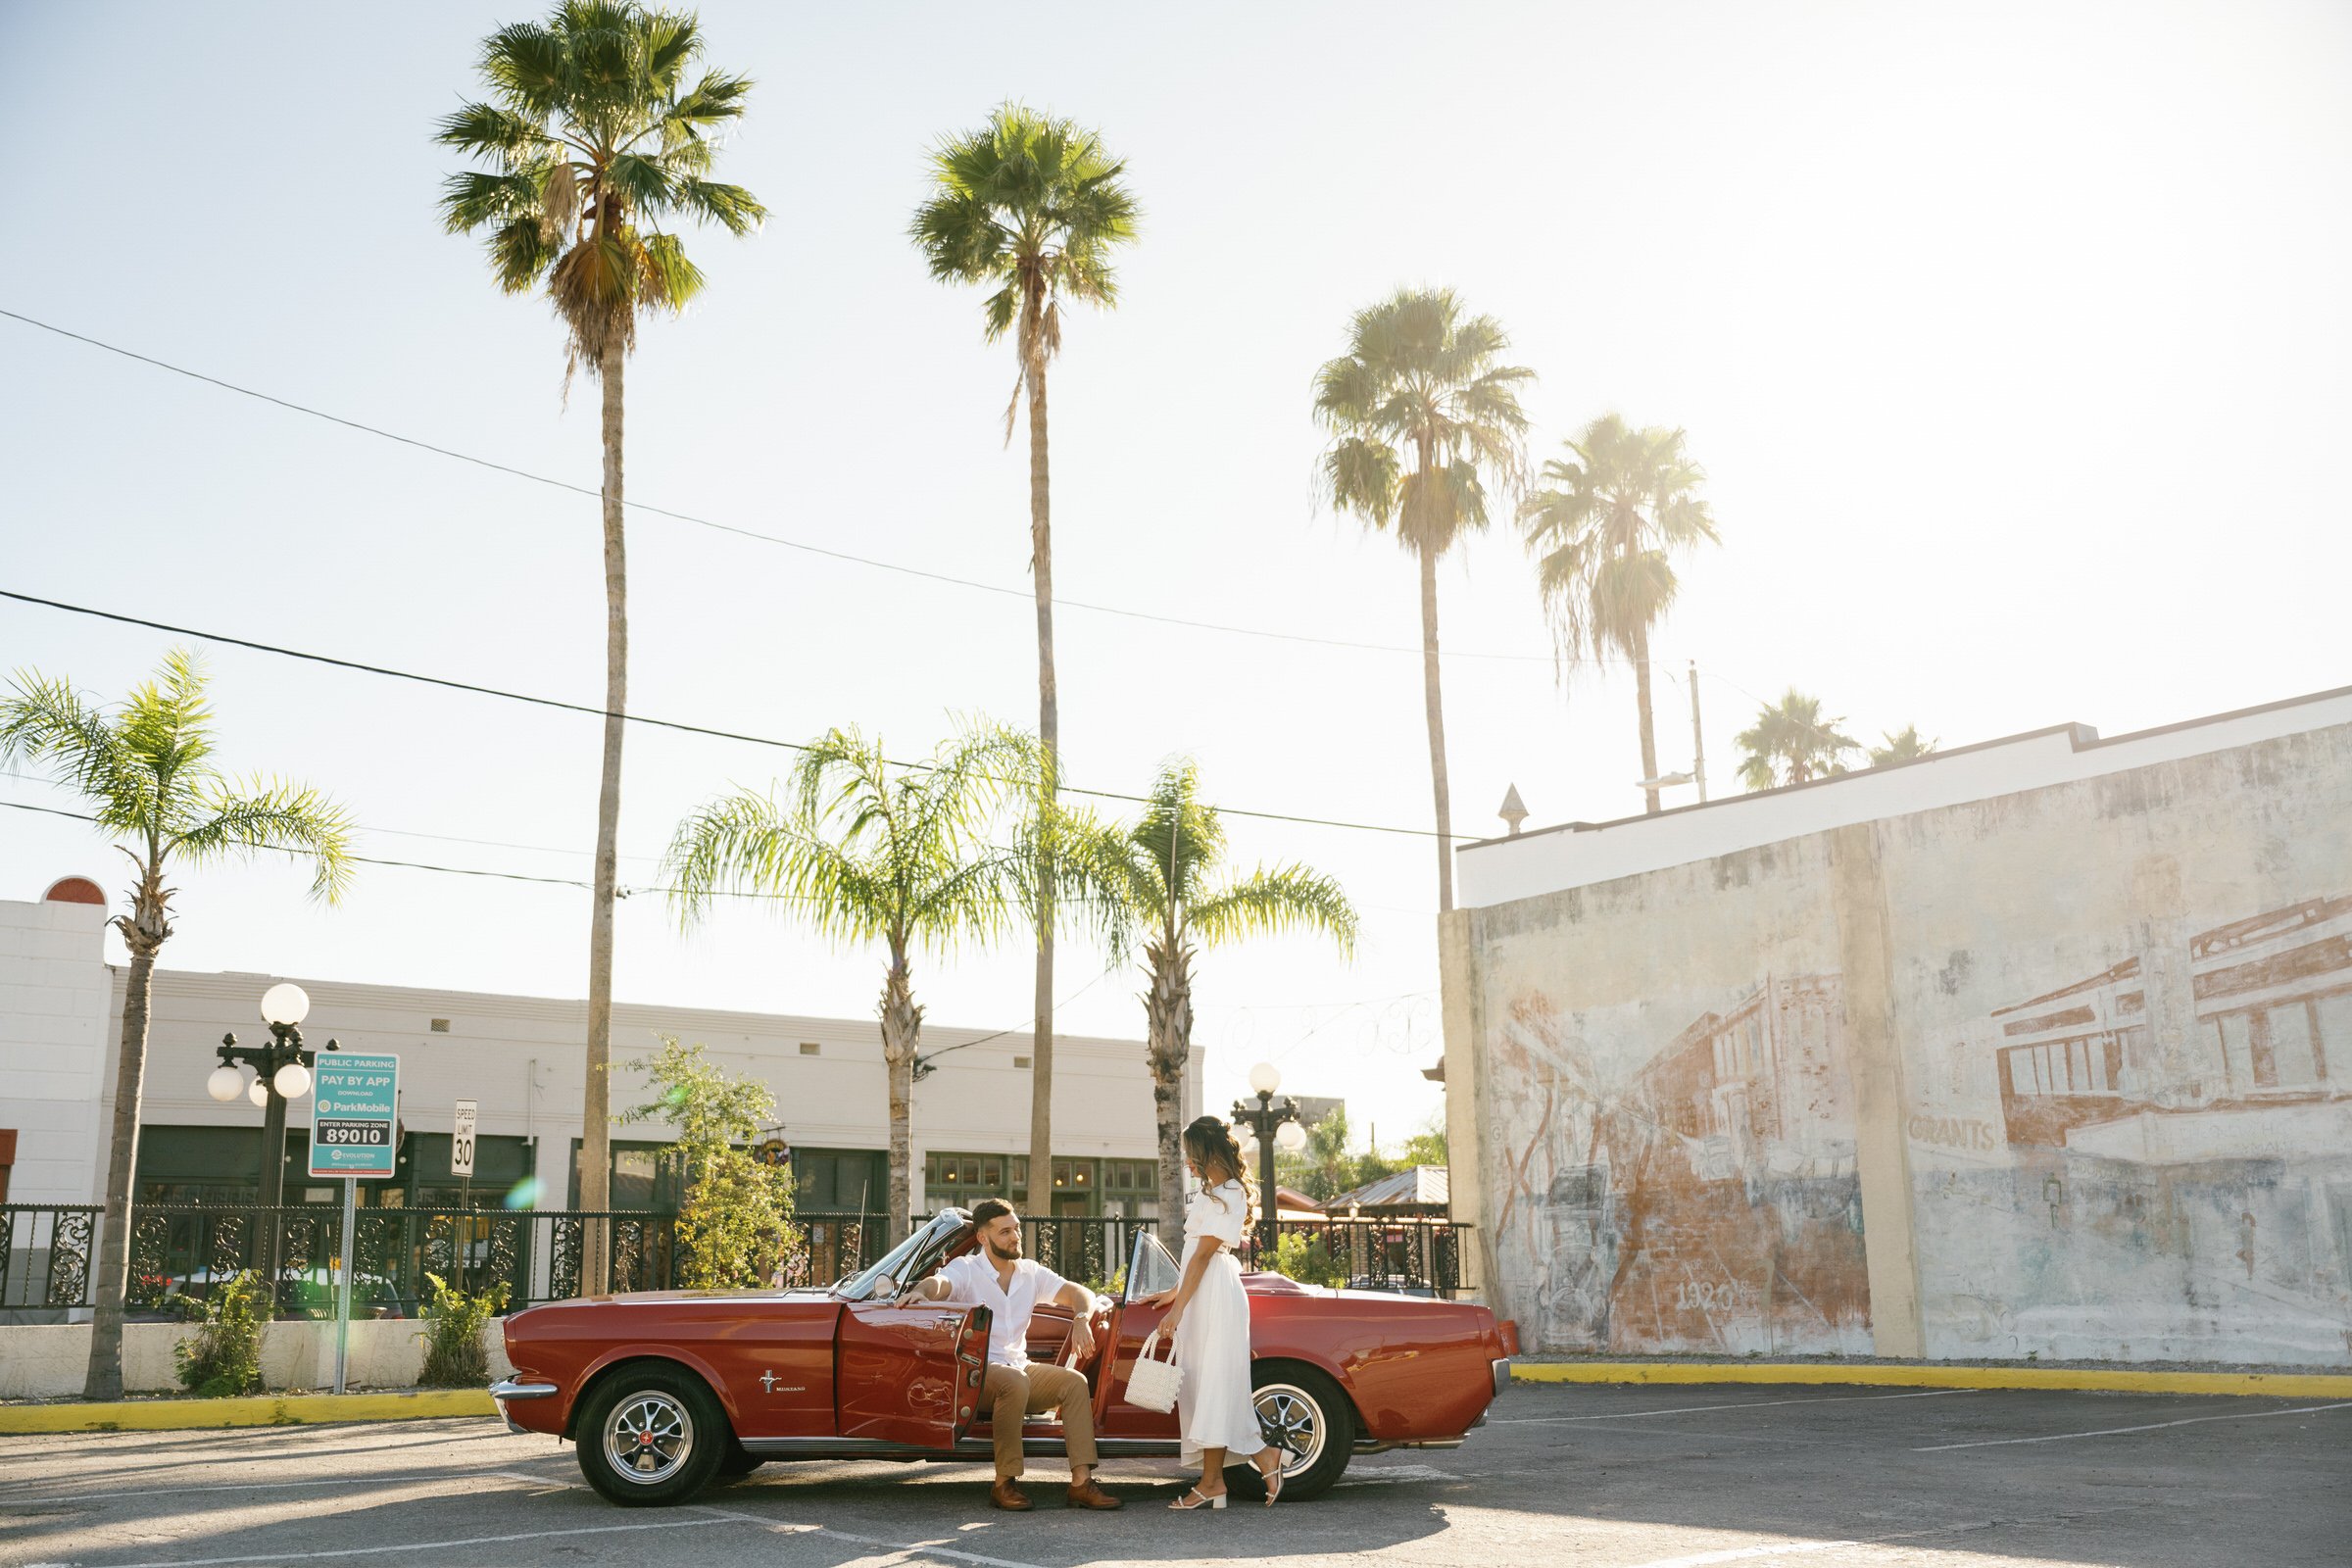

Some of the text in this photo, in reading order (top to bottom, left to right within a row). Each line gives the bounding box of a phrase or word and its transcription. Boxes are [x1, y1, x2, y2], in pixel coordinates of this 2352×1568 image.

[318, 1058, 395, 1068] PUBLIC PARKING
[320, 1075, 391, 1087] PAY BY APP
[333, 1102, 391, 1113] ParkMobile
[457, 1108, 476, 1120] SPEED
[458, 1124, 472, 1135] LIMIT
[1908, 1114, 1995, 1152] GRANTS
[326, 1128, 381, 1145] 89010
[455, 1138, 472, 1166] 30
